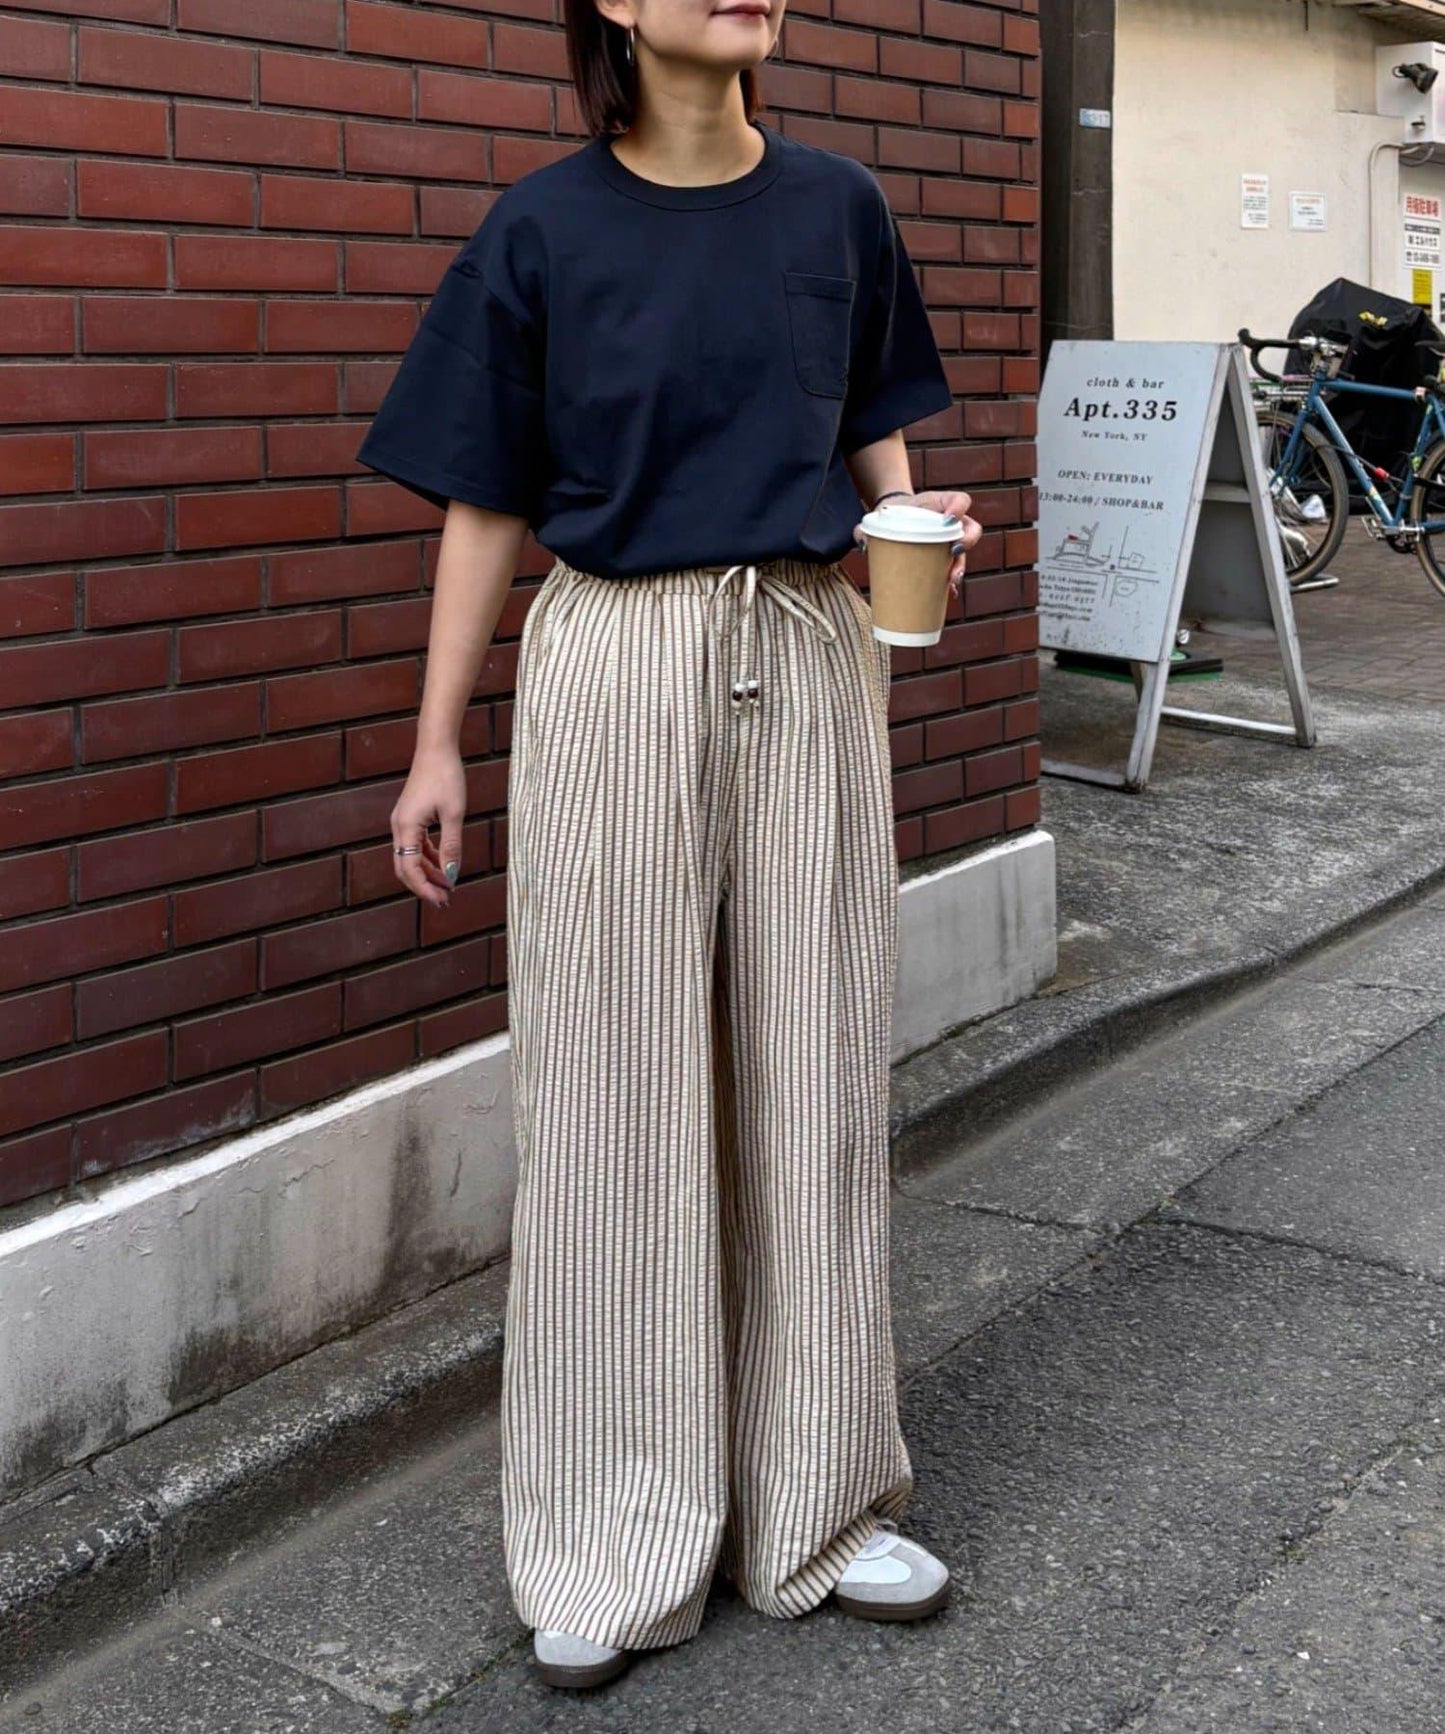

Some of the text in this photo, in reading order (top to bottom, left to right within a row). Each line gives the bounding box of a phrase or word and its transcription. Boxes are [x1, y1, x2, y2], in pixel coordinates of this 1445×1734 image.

[1086, 377, 1165, 389] cloth & bar
[1063, 397, 1178, 422] Apt.335
[1081, 430, 1148, 441] New York, NY
[1058, 469, 1154, 485] OPEN: EVERYDAY
[1102, 497, 1164, 511] SHOP&BAR
